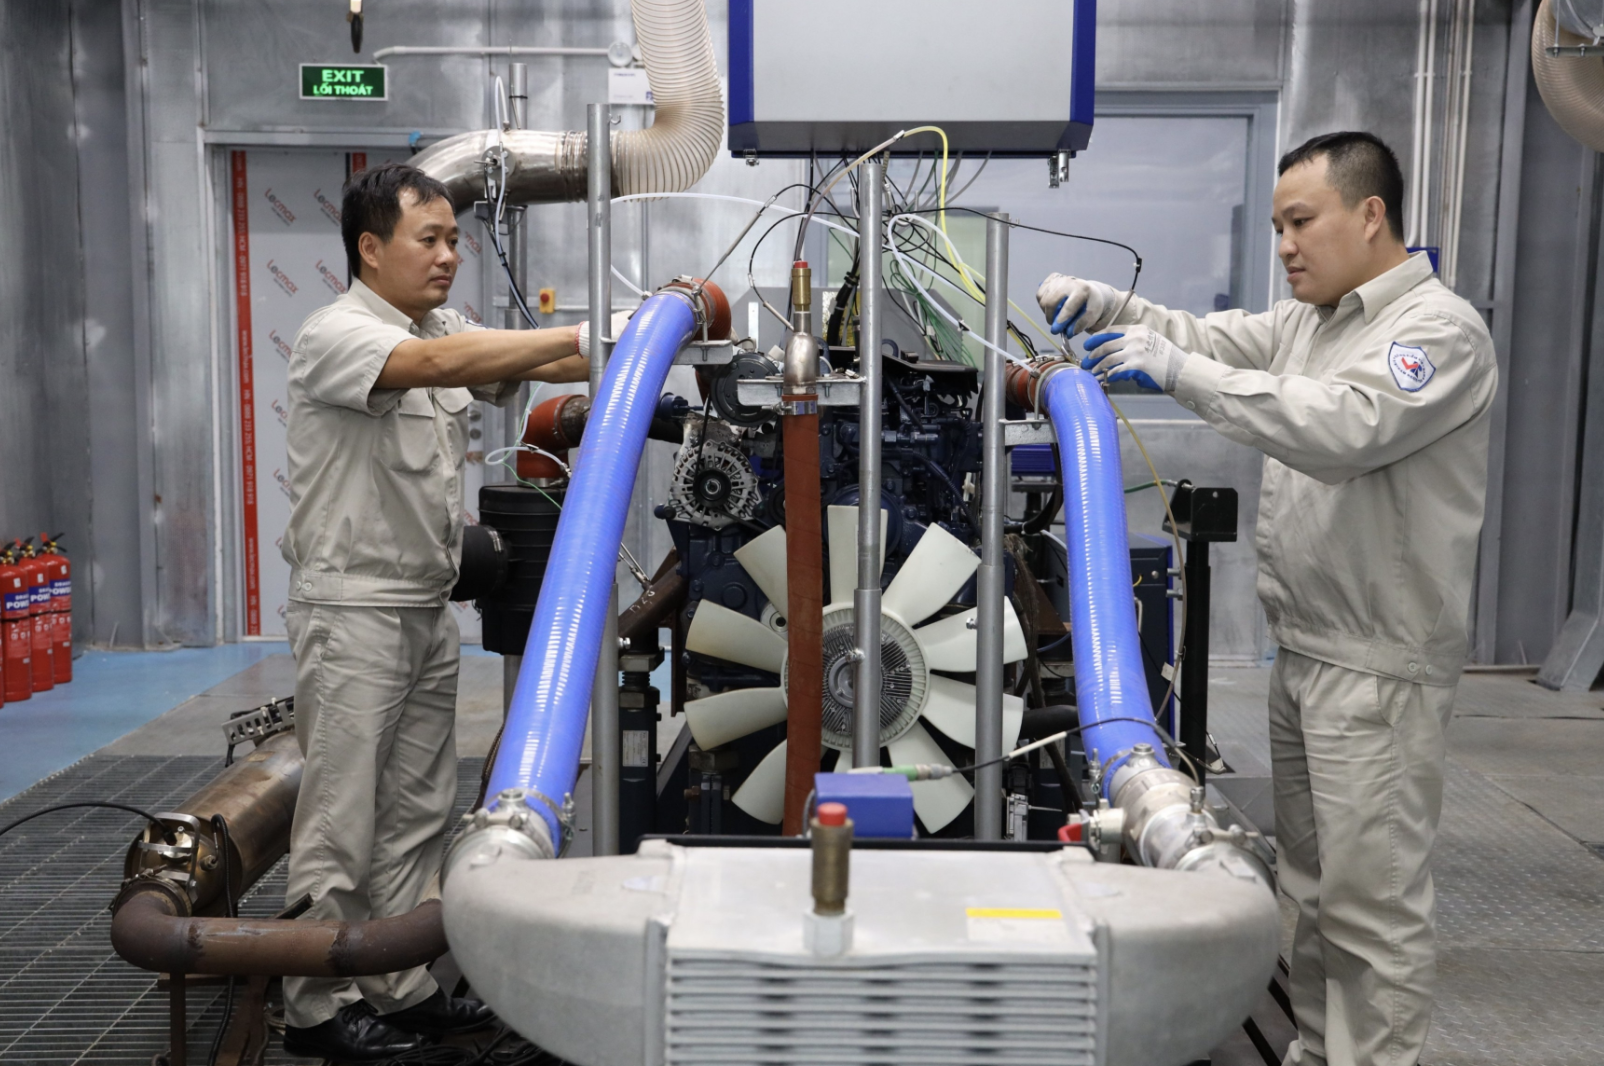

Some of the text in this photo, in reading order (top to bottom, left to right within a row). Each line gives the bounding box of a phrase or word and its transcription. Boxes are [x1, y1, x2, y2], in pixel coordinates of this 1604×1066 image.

[322, 69, 364, 82] EXIT
[313, 82, 373, 95] LỐI THOÁT
[265, 188, 296, 223] Lecmax
[267, 259, 298, 294] Lecmax
